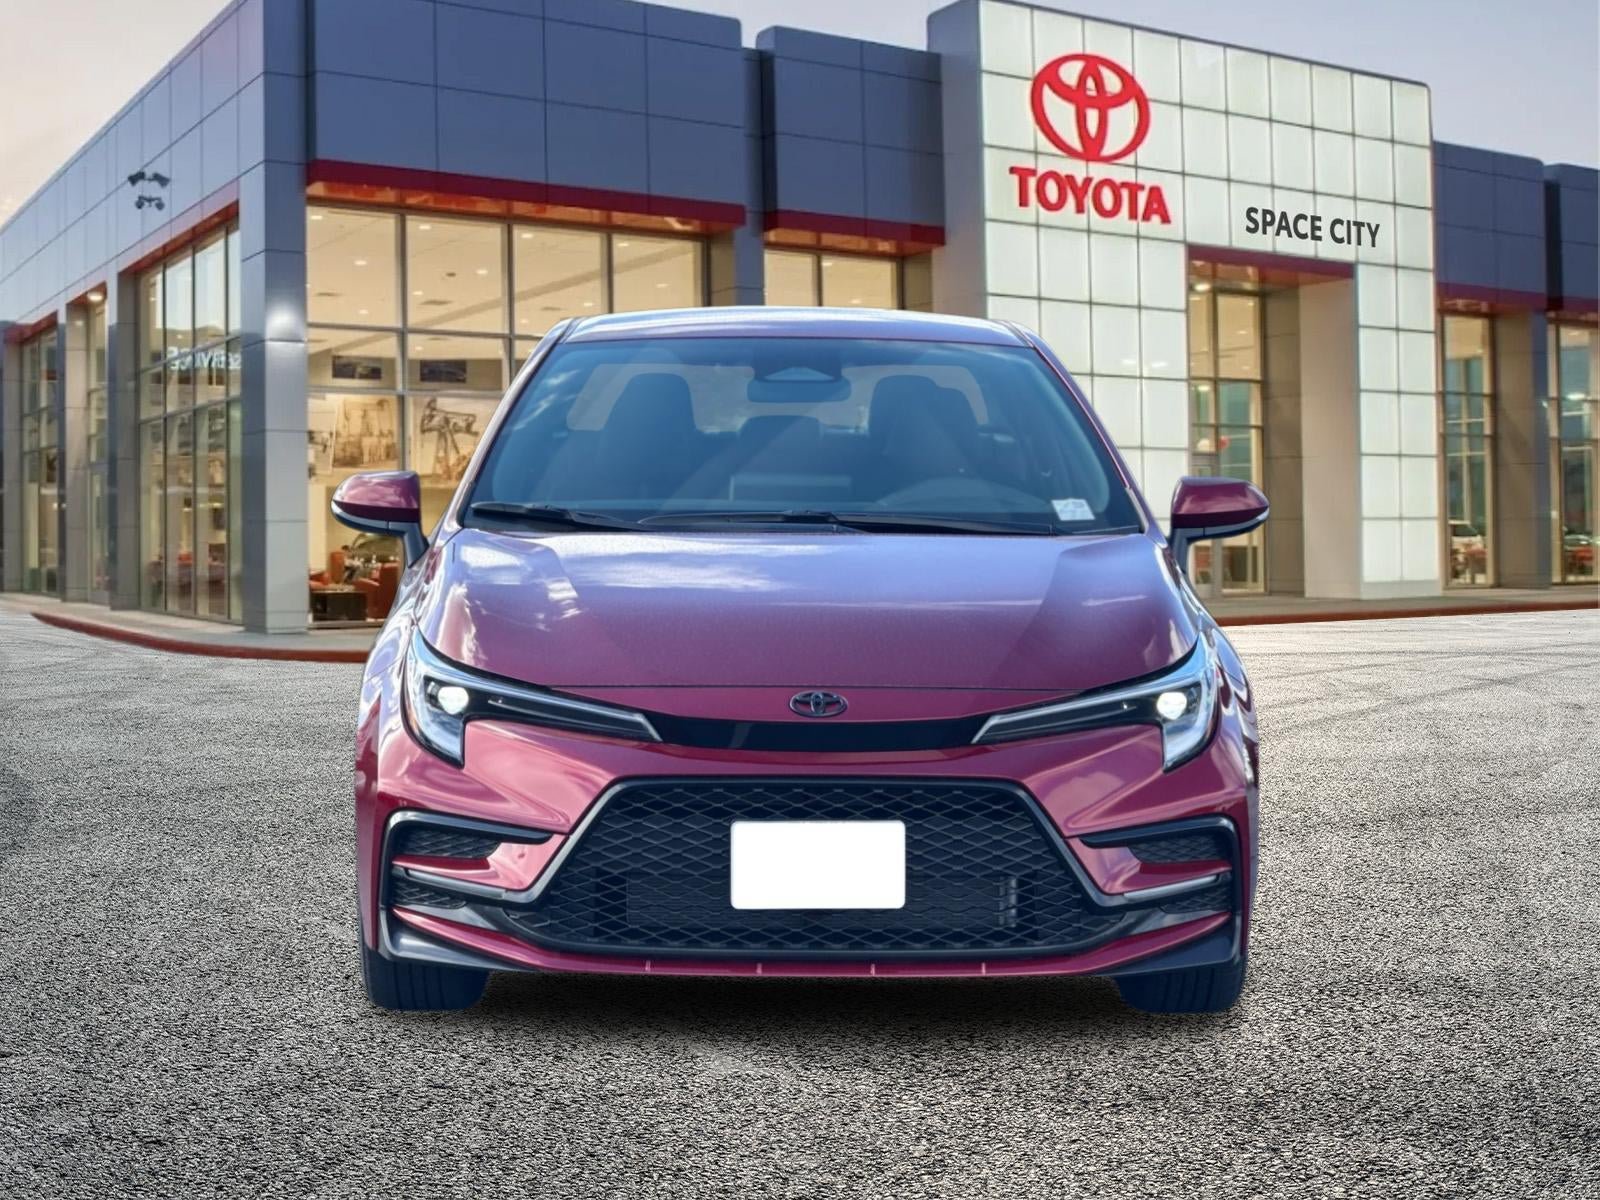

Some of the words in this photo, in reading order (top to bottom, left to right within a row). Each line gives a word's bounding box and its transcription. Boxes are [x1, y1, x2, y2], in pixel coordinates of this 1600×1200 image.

[1009, 166, 1171, 224] TOYOTA
[1245, 206, 1322, 242] SPACE
[1329, 218, 1381, 248] CITY
